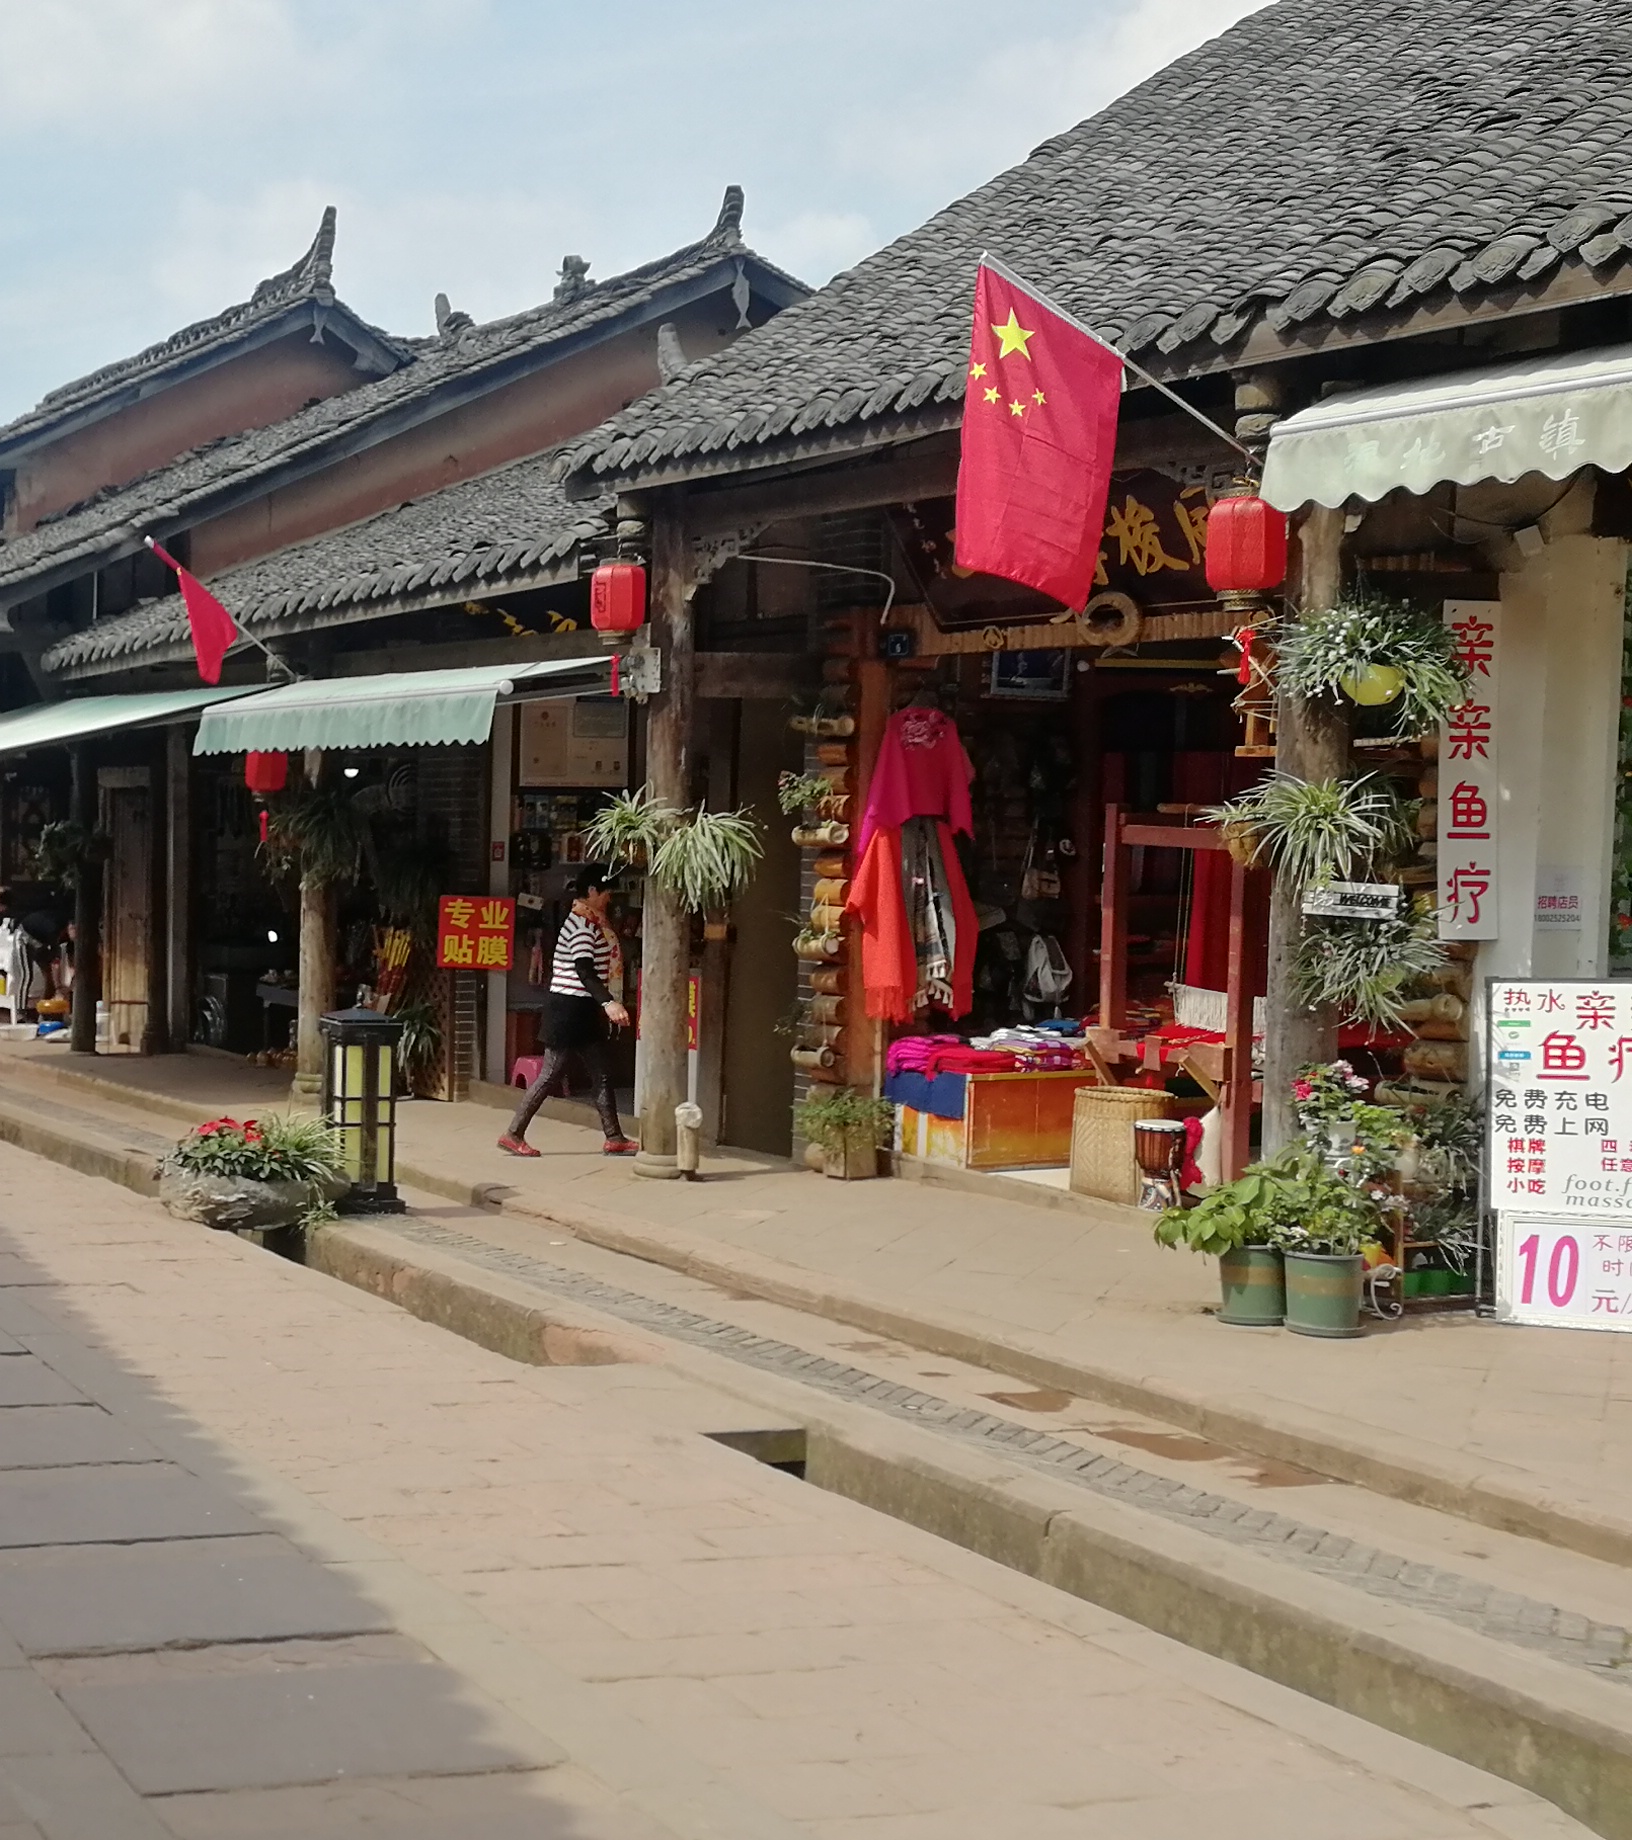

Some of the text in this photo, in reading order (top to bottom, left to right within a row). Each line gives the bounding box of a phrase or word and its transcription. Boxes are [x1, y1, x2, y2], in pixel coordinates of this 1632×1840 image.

[1446, 615, 1494, 924] 亲亲鱼疗
[1538, 895, 1579, 909] 招聘店员
[445, 899, 509, 929] 专业
[443, 934, 508, 966] 贴膜
[1504, 988, 1565, 1013] 热水
[1576, 990, 1632, 1030] 亲
[1494, 1089, 1609, 1111] 免费充电
[1494, 1114, 1609, 1136] 免费上网
[1507, 1138, 1546, 1154] 棋牌
[1507, 1158, 1546, 1174] 按摩
[1507, 1178, 1546, 1195] 小吃
[1518, 1234, 1579, 1307] 10
[1603, 1259, 1632, 1277] 时
